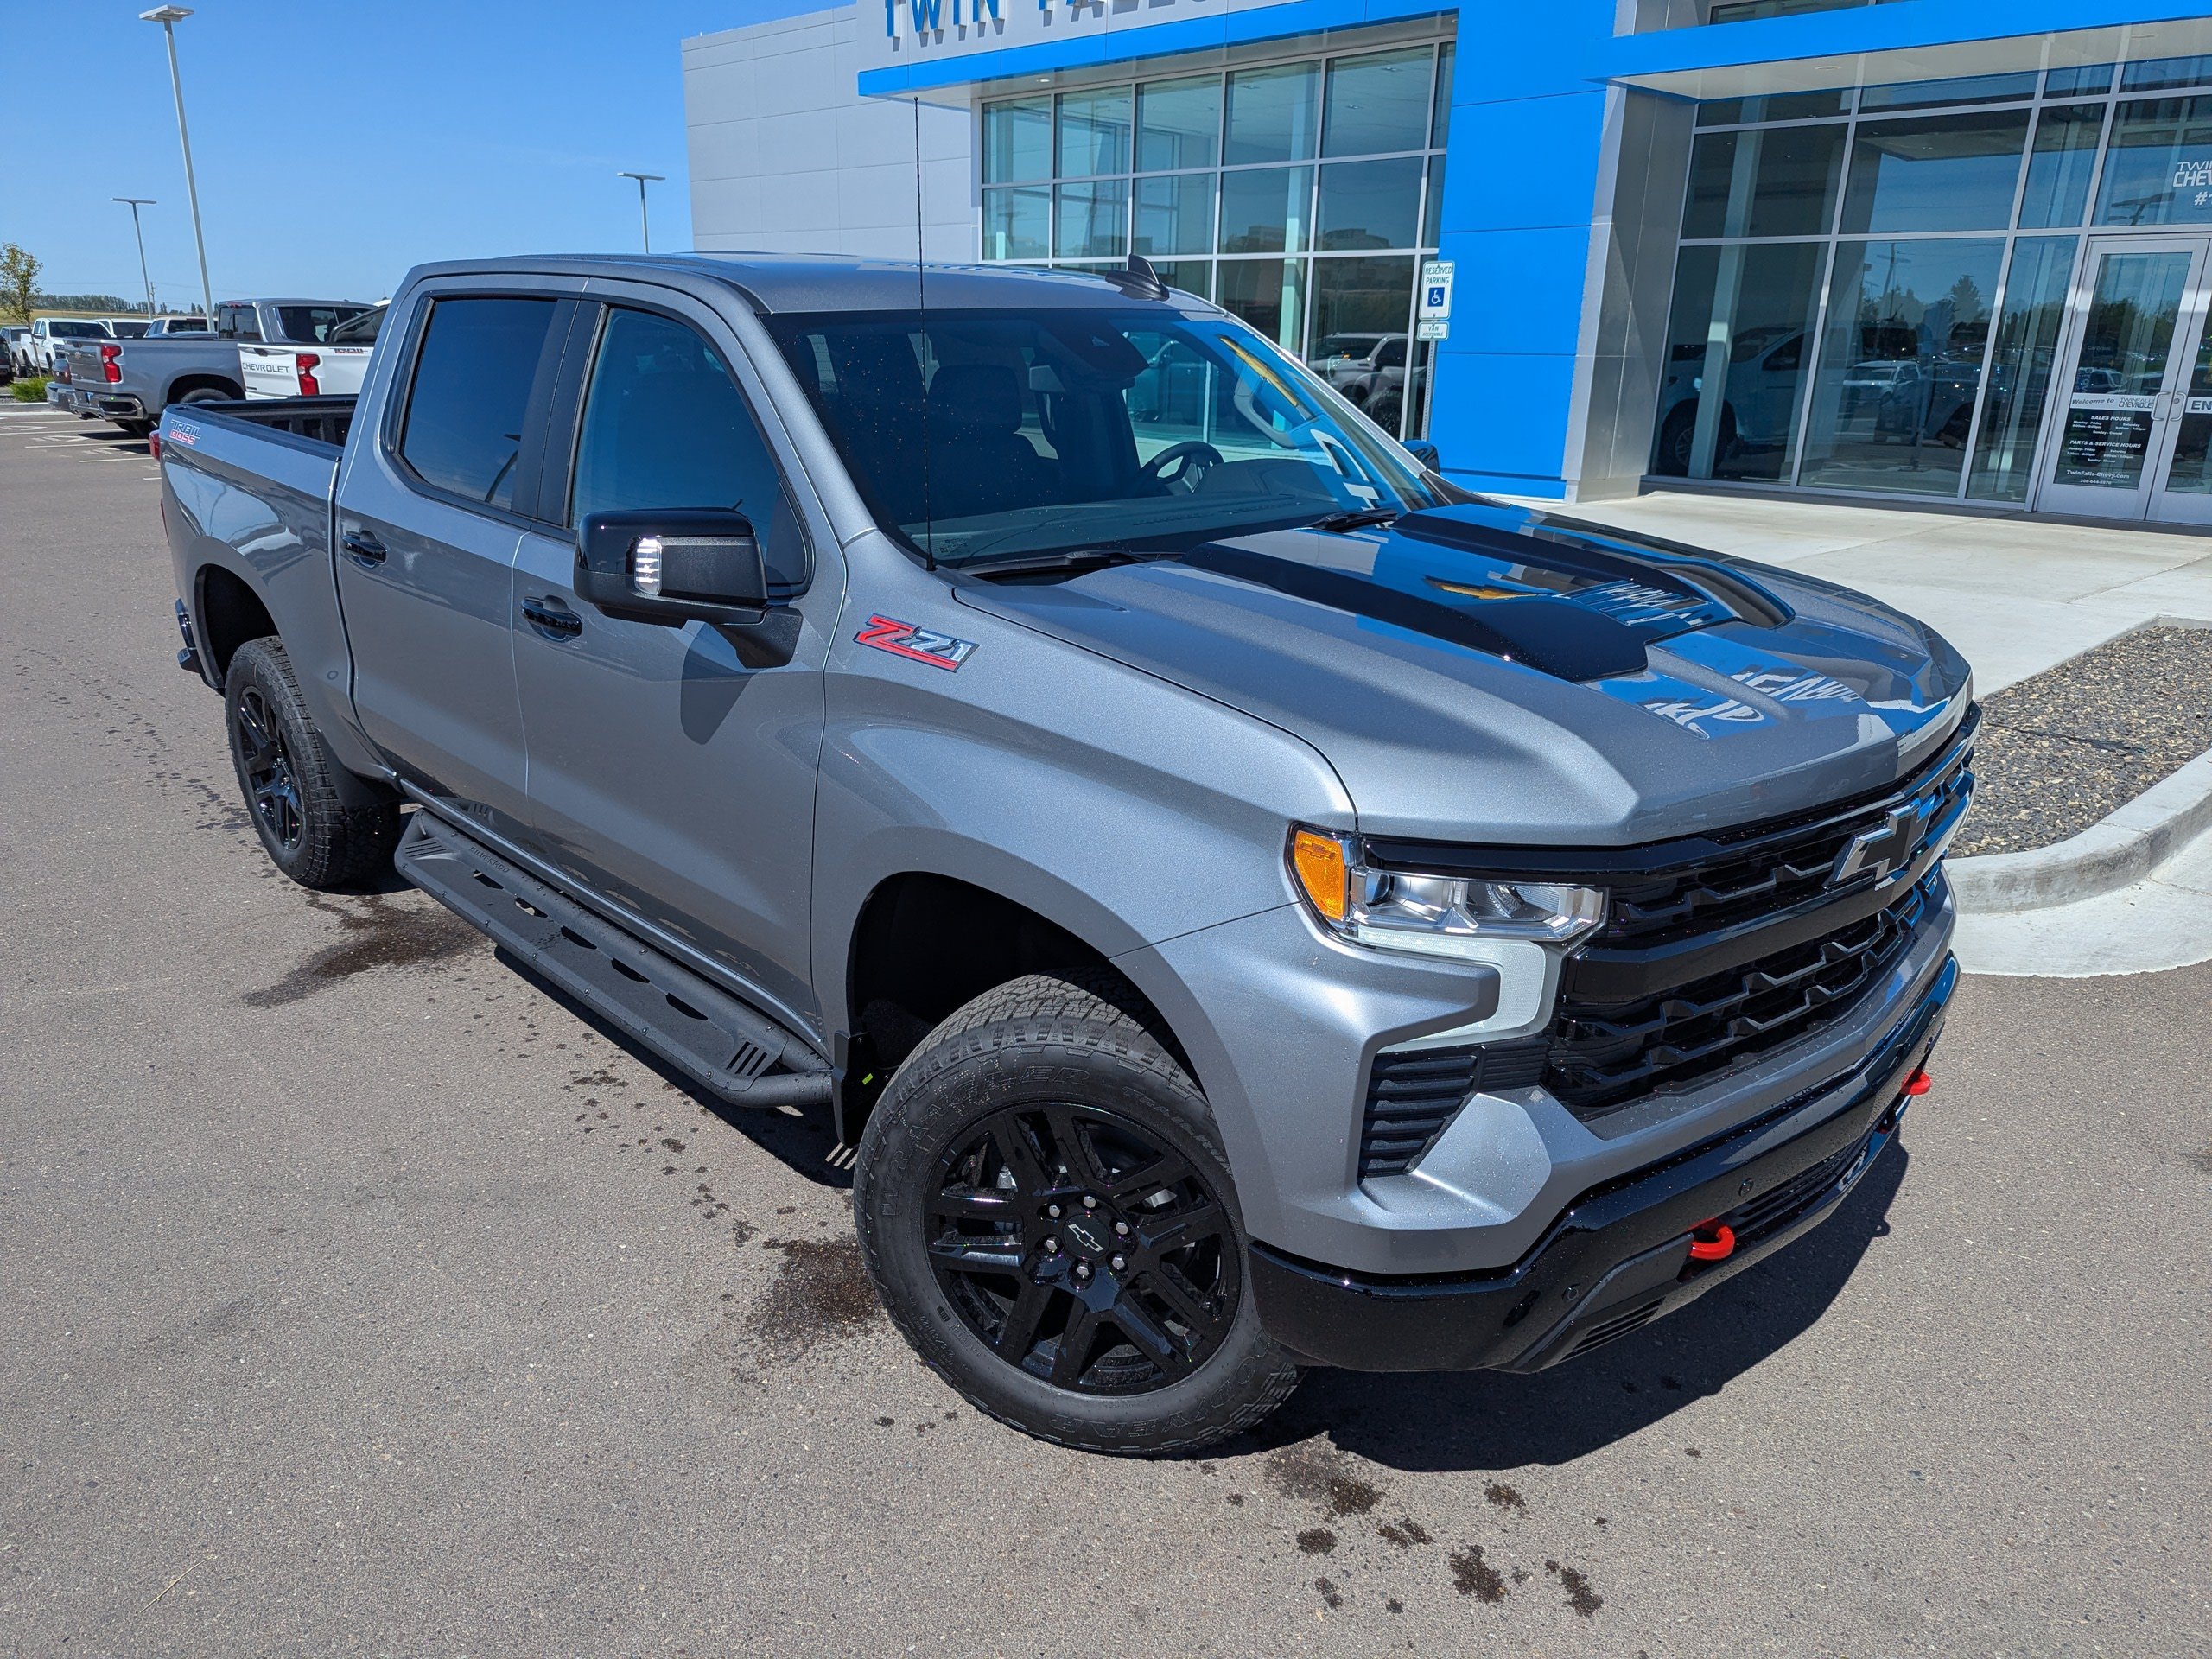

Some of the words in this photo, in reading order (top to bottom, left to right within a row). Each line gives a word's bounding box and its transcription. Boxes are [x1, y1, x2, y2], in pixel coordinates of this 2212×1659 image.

[1425, 266, 1452, 275] RESERVED
[1426, 276, 1449, 285] PARKING
[242, 362, 290, 373] CHEVROLET
[170, 418, 201, 440] TRAIL
[169, 429, 196, 446] BOSS
[852, 613, 981, 673] Z71
